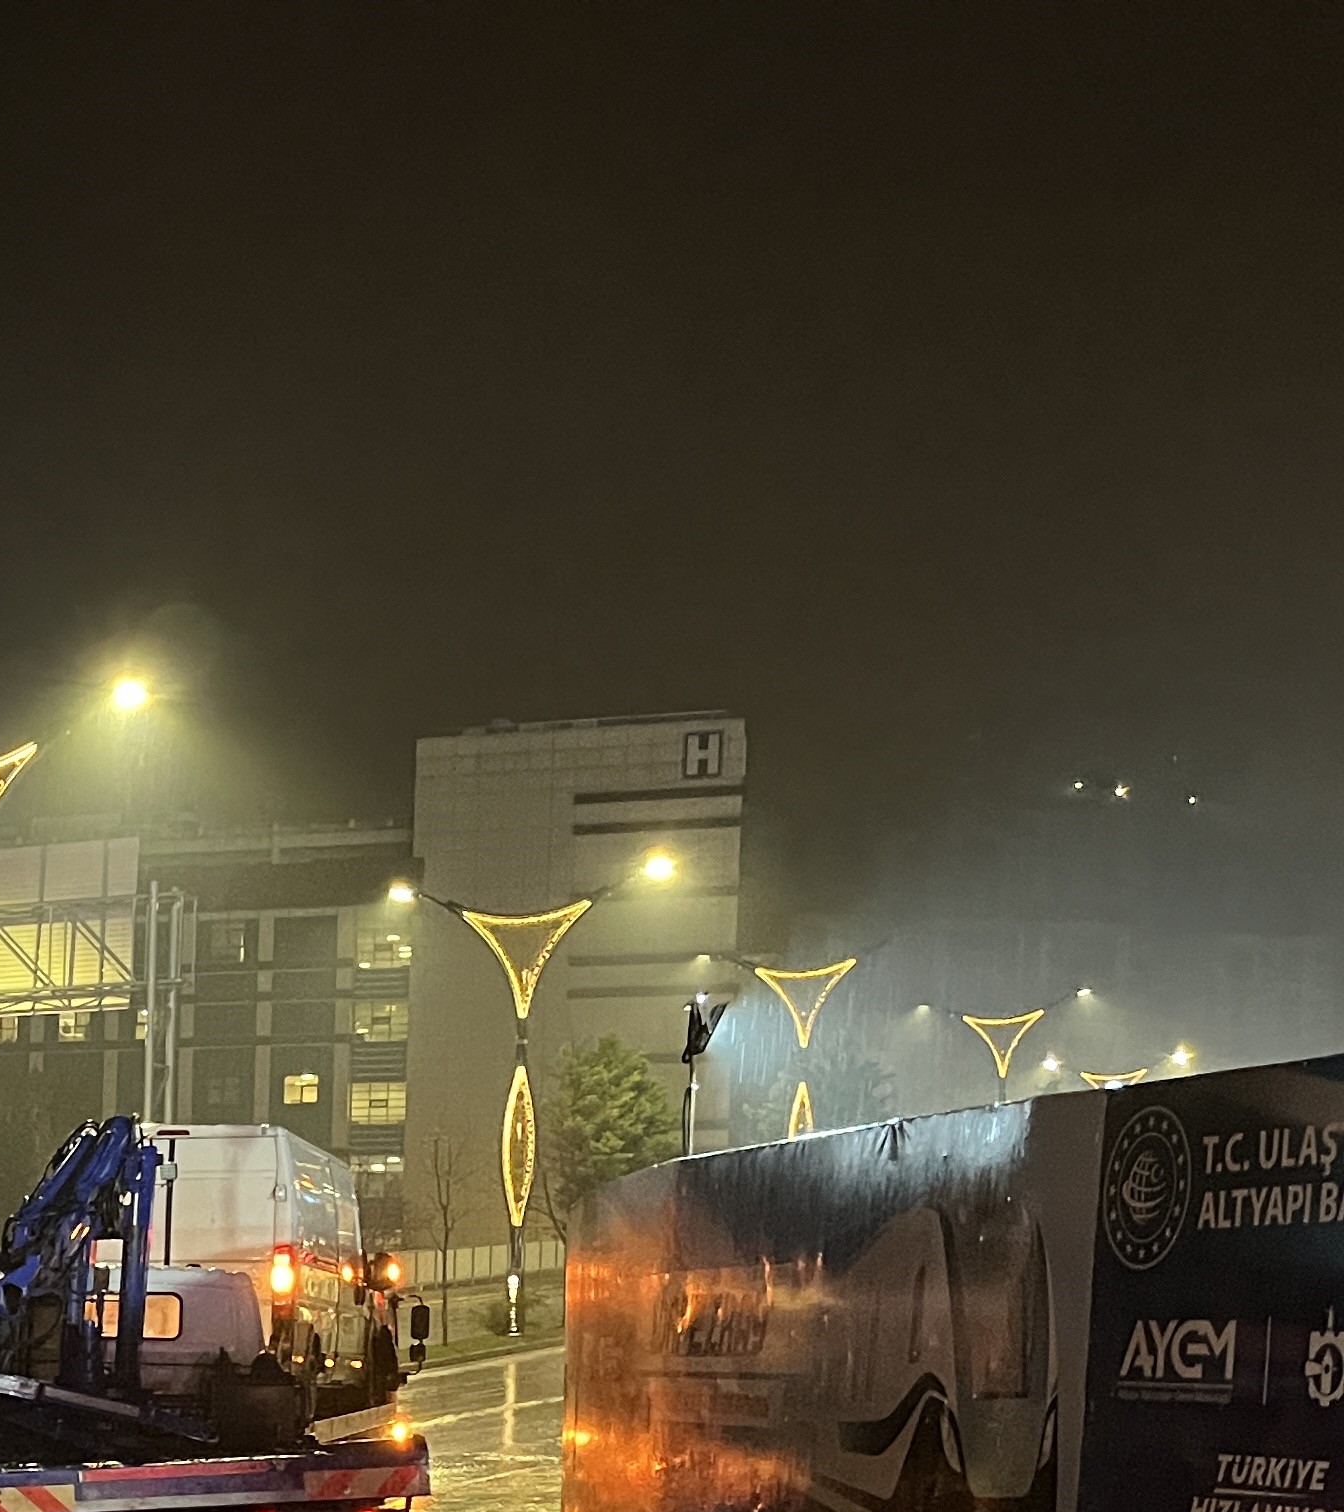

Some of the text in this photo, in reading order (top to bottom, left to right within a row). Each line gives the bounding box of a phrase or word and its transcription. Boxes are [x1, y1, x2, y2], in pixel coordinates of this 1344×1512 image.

[685, 733, 721, 776] H
[1202, 1123, 1344, 1176] T.C. ULAŞ
[1197, 1182, 1344, 1229] ALTYAPI B
[1120, 1319, 1237, 1380] AYGM
